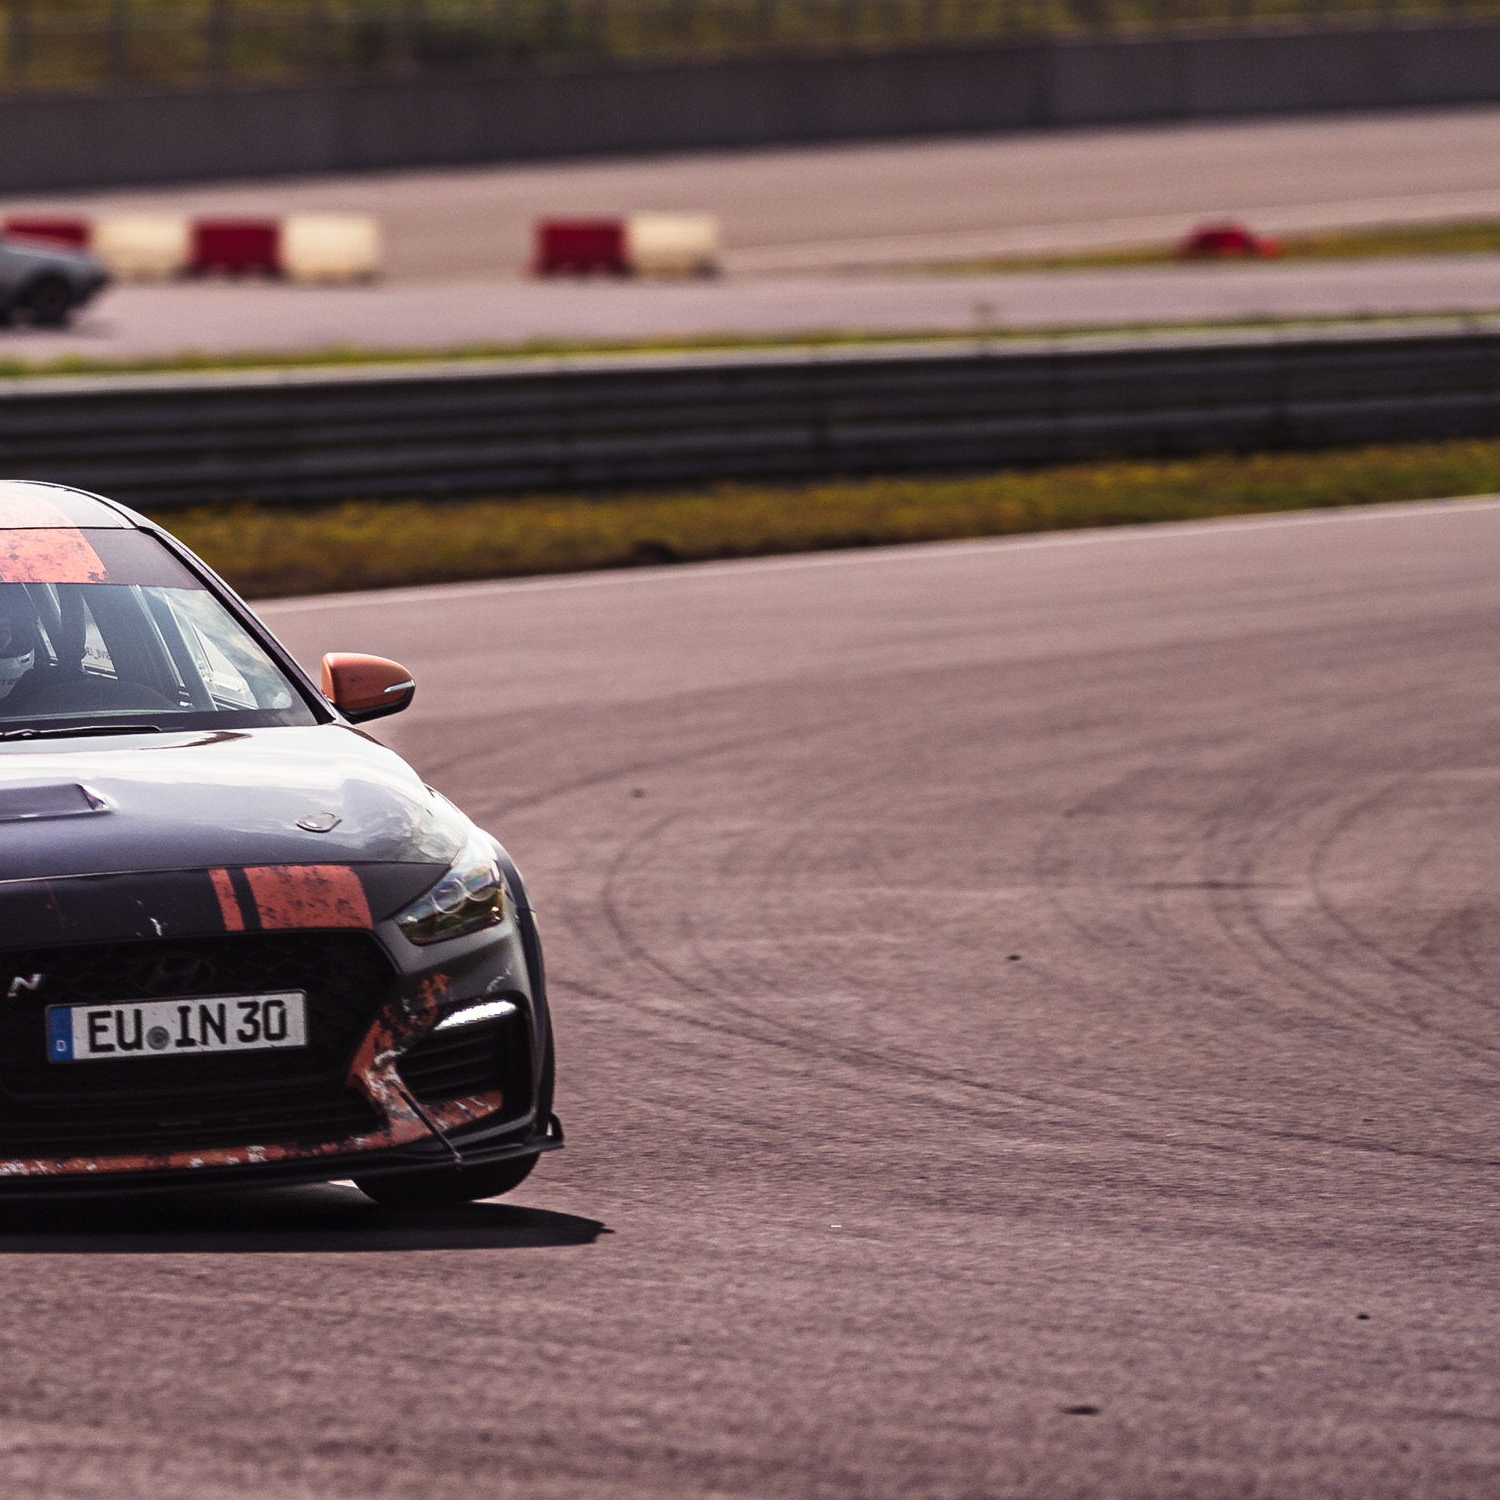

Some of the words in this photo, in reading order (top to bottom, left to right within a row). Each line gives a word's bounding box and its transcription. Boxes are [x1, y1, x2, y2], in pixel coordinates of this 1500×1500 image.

[87, 1009, 143, 1053] EU
[175, 1003, 227, 1048] IN
[237, 999, 287, 1043] 30
[56, 1039, 68, 1052] D
